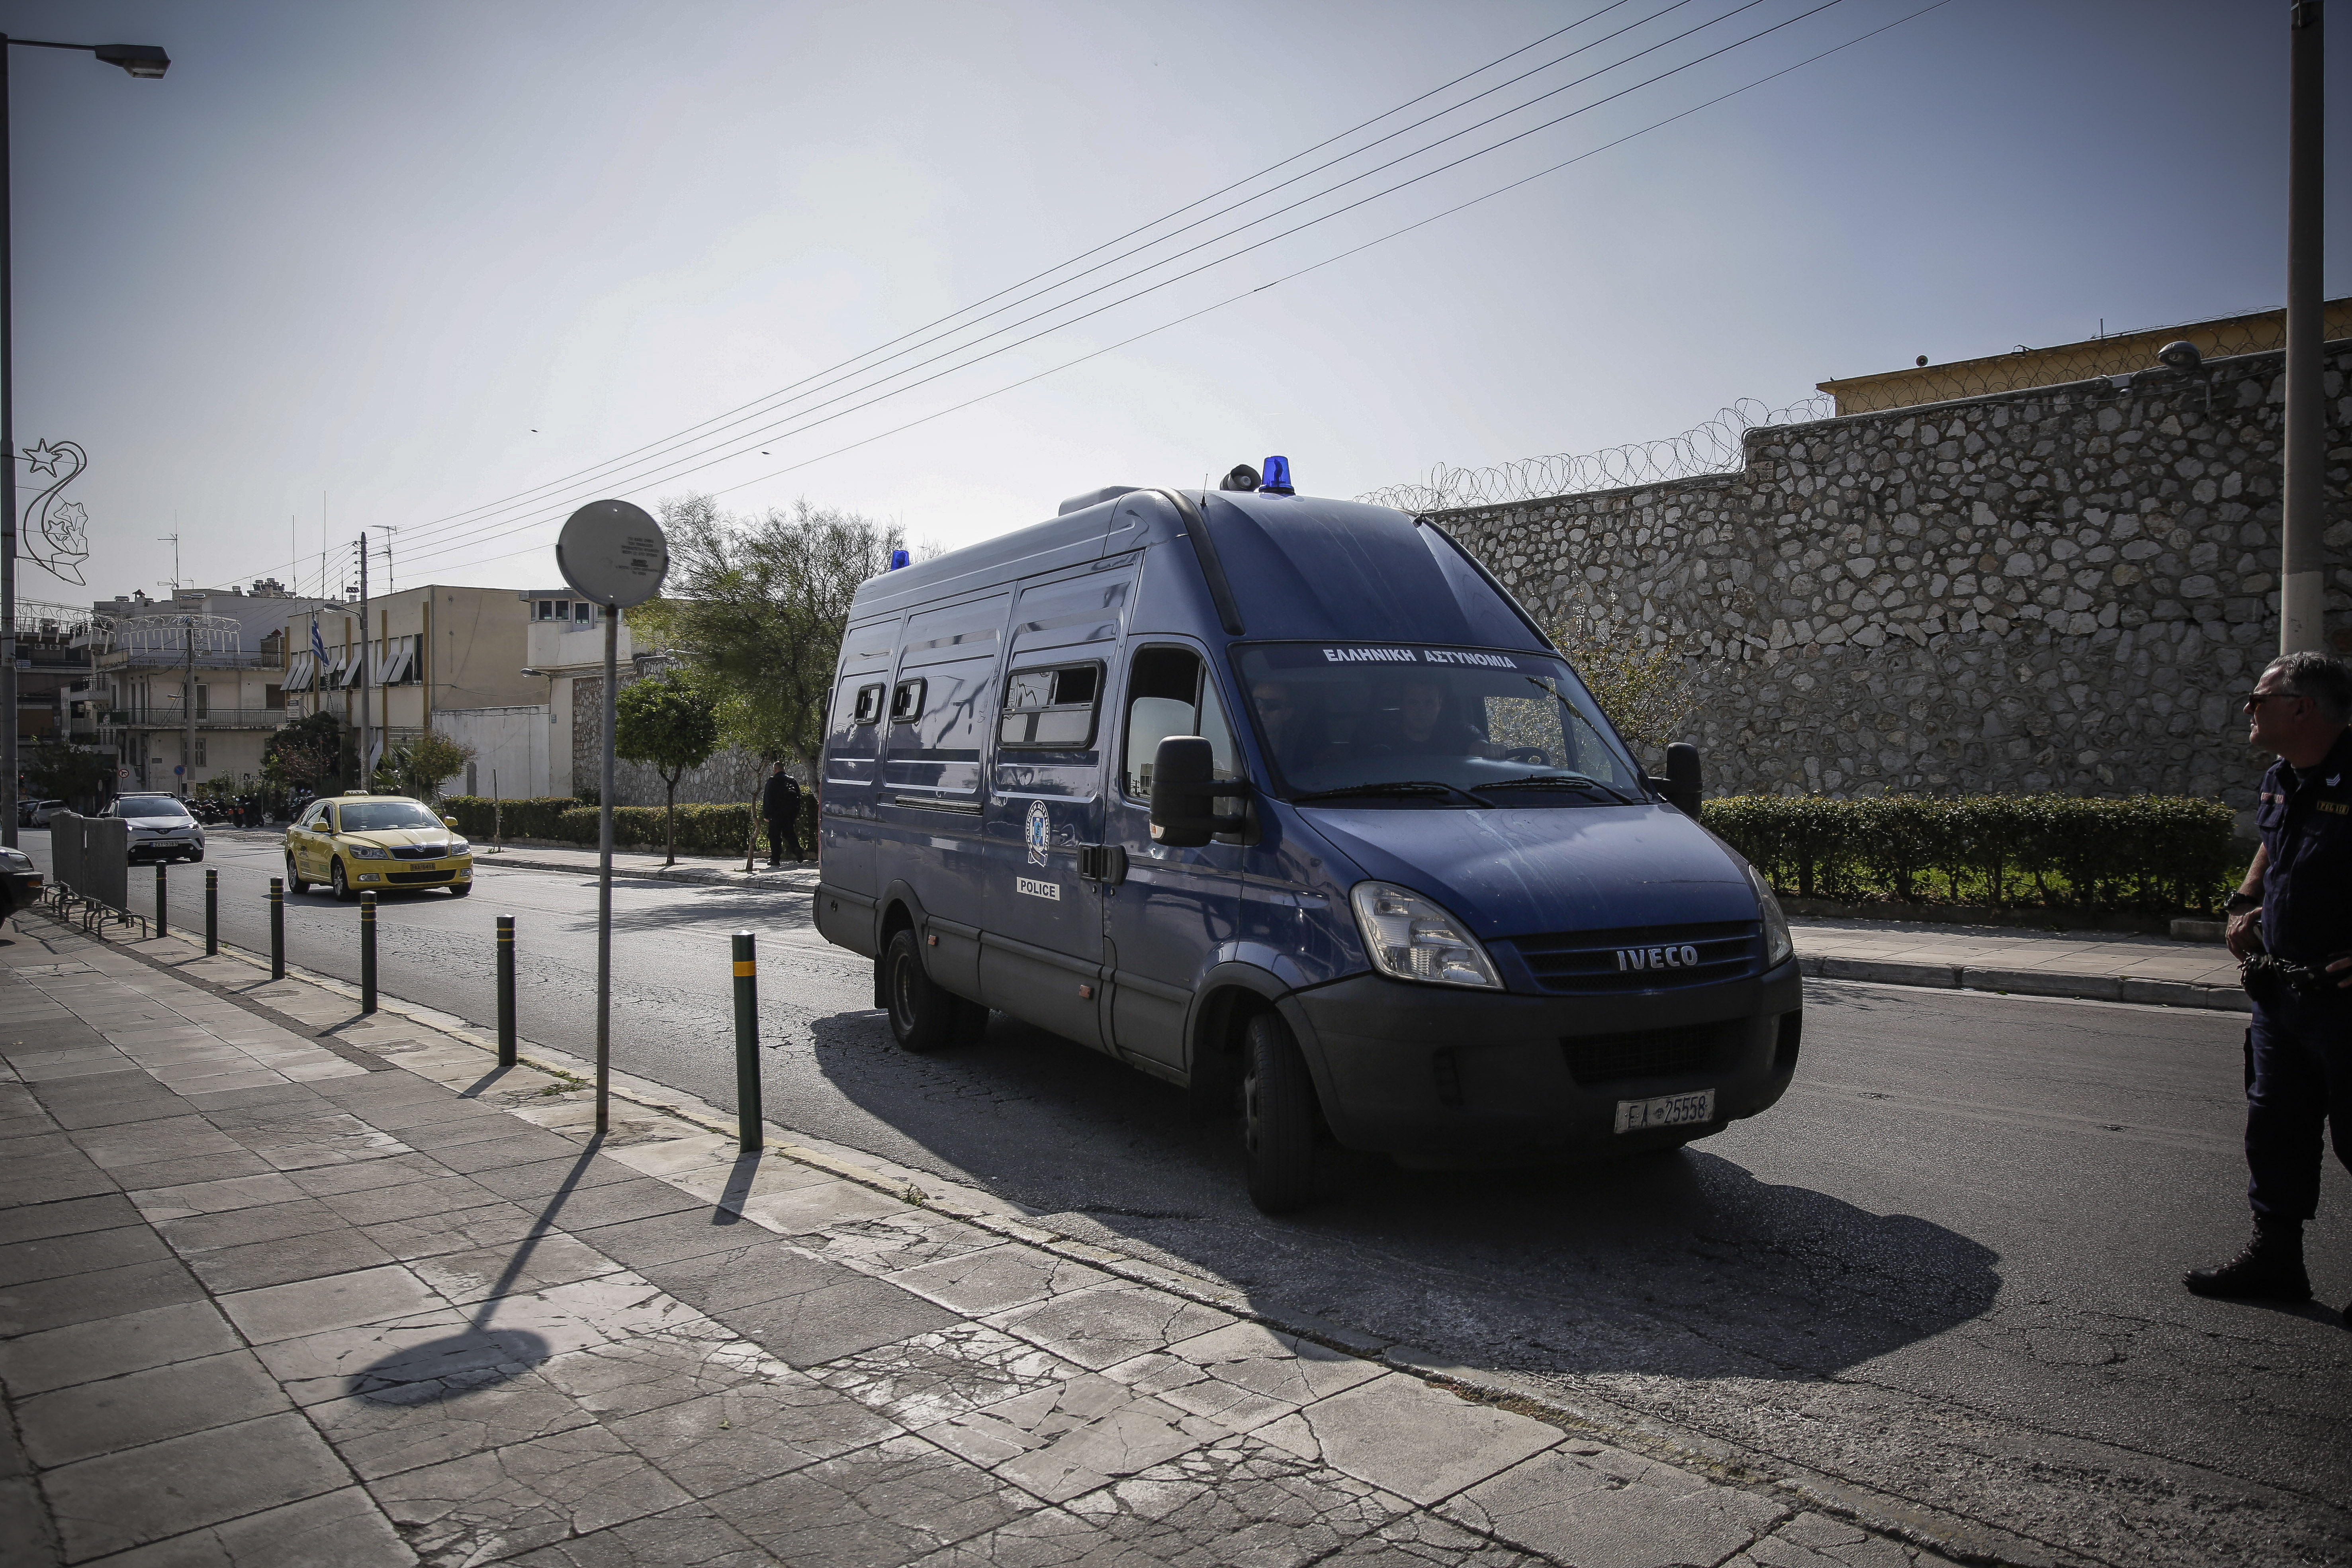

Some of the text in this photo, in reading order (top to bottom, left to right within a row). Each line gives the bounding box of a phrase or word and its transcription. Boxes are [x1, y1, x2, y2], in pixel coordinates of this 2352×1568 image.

[1323, 649, 1517, 668] ΕΛΛΗΝΙΚΗ ΑΣΤΥΝΟΜΙΑ
[1021, 880, 1055, 897] POLICE
[1617, 946, 1697, 971] IVECO
[1663, 1095, 1706, 1124] 25558
